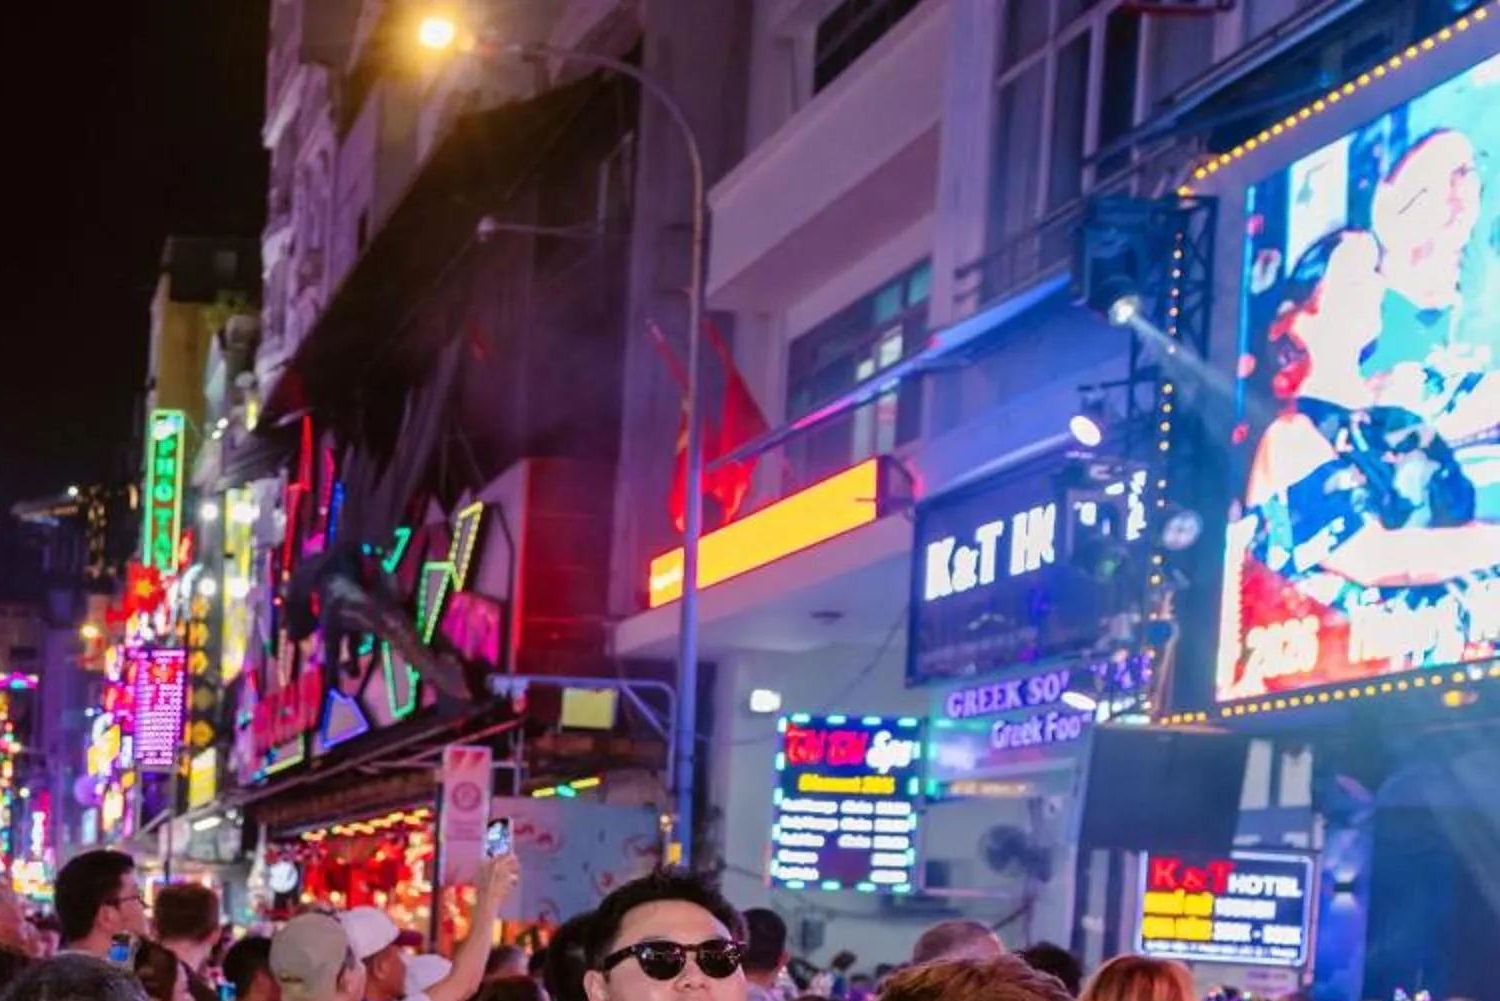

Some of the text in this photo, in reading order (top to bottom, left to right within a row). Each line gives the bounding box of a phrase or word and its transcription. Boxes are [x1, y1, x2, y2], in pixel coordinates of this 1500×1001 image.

[947, 680, 1022, 718] GREEK
[991, 710, 1093, 749] Greek Foo
[1227, 872, 1304, 898] HOTEL
